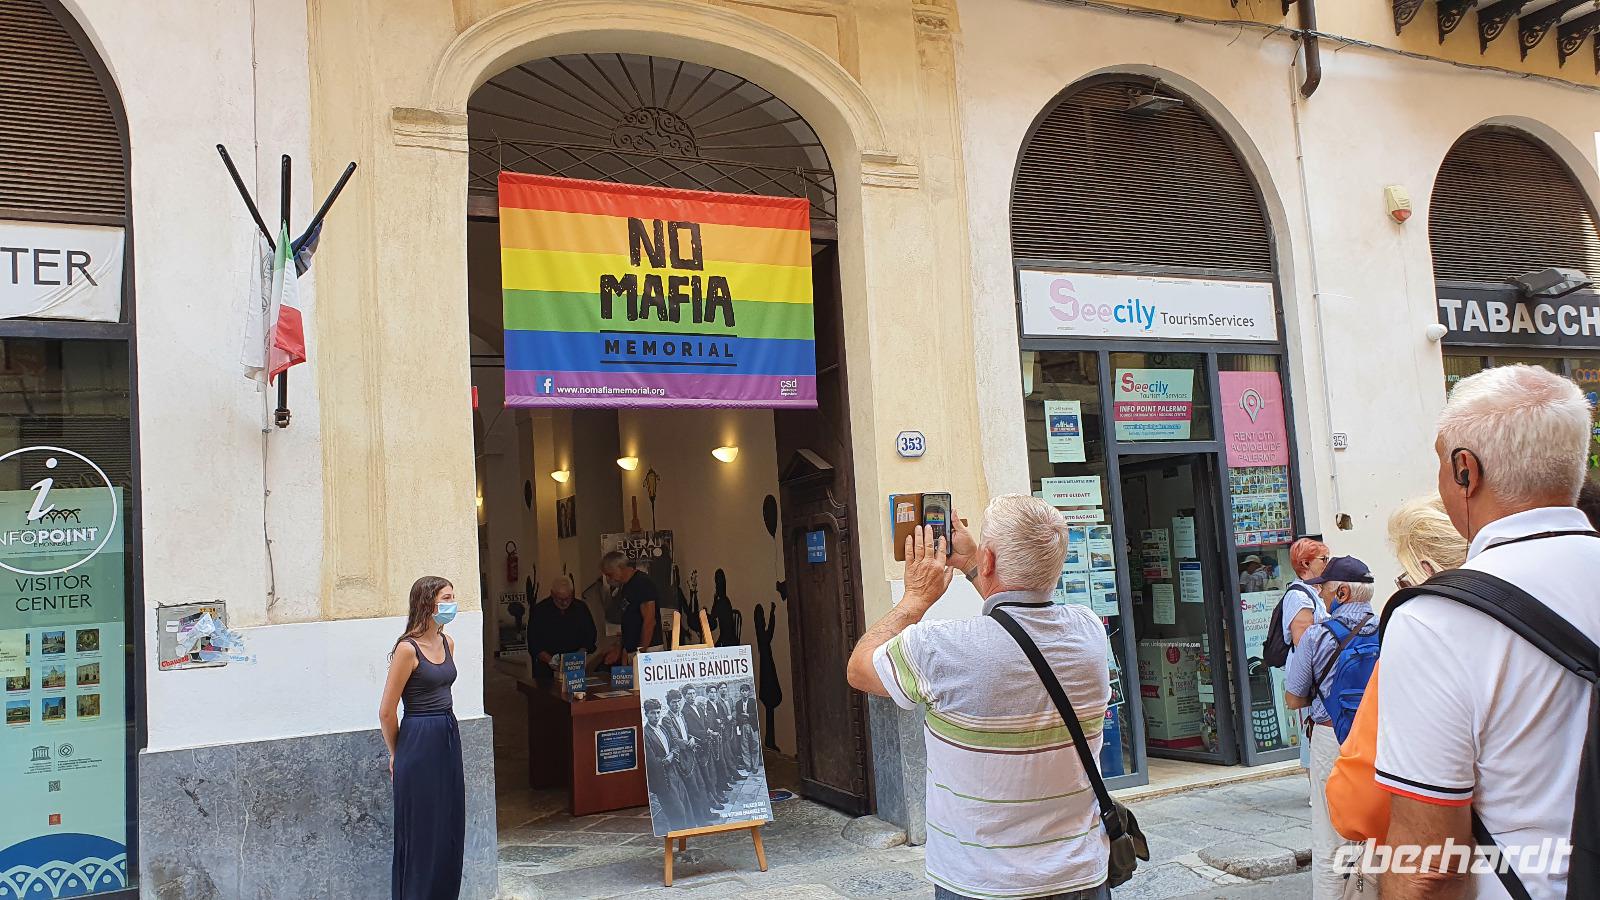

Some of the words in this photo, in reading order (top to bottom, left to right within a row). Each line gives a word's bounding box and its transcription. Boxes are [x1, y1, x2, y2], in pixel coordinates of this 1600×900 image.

[628, 217, 704, 271] NO
[0, 247, 98, 287] TER
[599, 273, 736, 327] MAFIA
[1049, 278, 1155, 330] Seecily
[1438, 299, 1600, 337] TABACCH
[604, 339, 734, 358] MEMORIAL
[557, 386, 665, 396] www.nomafiamemorial.org
[780, 378, 797, 388] csd
[1121, 372, 1169, 395] Seecily
[1119, 405, 1135, 413] INFO
[1136, 405, 1156, 413] POINT
[901, 436, 923, 451] 353
[1333, 435, 1346, 447] 351
[15, 574, 93, 593] VISITOR
[15, 594, 93, 612] CENTER
[644, 662, 696, 682] SICILIAN
[699, 658, 749, 677] BANDITS
